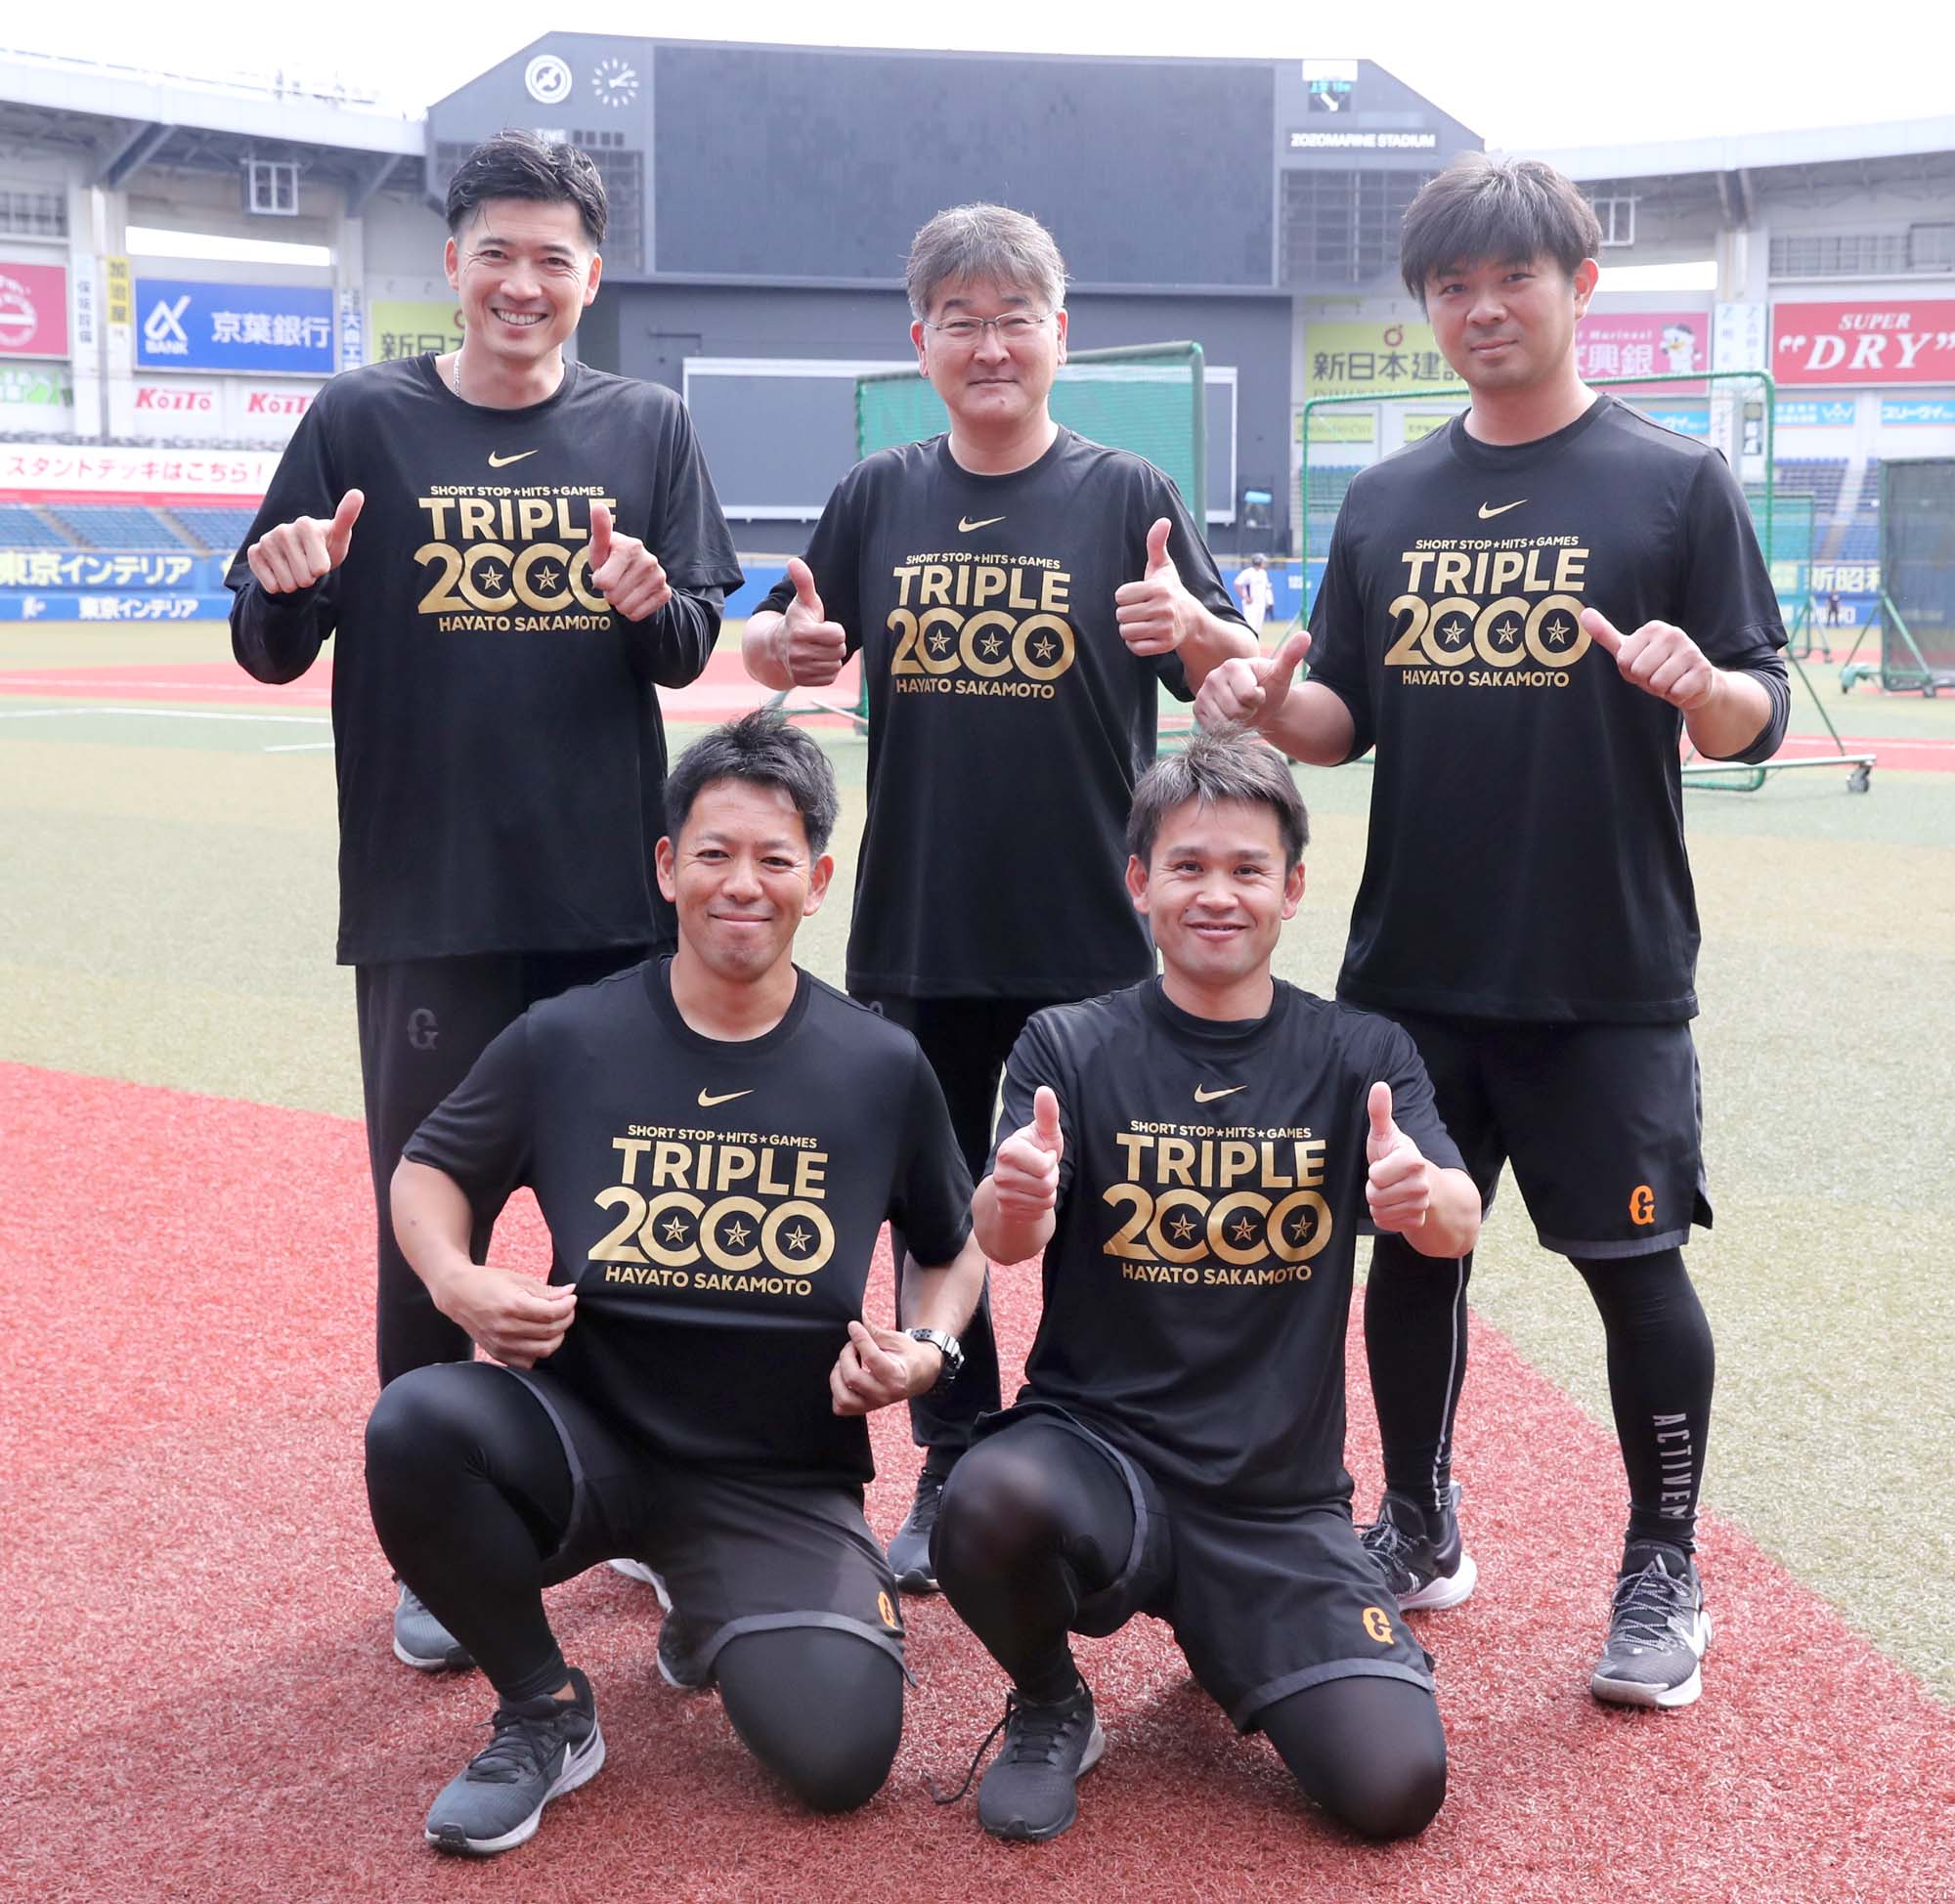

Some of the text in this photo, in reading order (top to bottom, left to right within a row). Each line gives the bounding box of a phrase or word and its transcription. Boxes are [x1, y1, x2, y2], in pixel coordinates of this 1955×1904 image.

[1377, 134, 1436, 148] STADIUM
[210, 311, 330, 349] 京葉銀行
[1838, 313, 1911, 330] SUPER
[146, 340, 189, 355] BANK
[380, 331, 464, 360] 新日
[431, 485, 474, 497] SHORT
[1415, 540, 1457, 550] SHORT
[0, 550, 193, 585] 東京インテリア
[905, 552, 940, 565] SHORT
[1401, 548, 1589, 595] TRIPLE
[892, 564, 1071, 614] TRIPLE
[78, 596, 199, 621] 東京インテリア
[439, 616, 611, 632] HAYATO SAKAMOTO
[895, 678, 1055, 700] HAYATO SAKAMOTO
[1403, 670, 1570, 688] HAYATO SAKAMOTO
[406, 1008, 439, 1051] G
[628, 1124, 675, 1140] SHORT
[1130, 1120, 1177, 1136] SHORT
[612, 1137, 829, 1199] TRIPLE
[1115, 1132, 1326, 1189] TRIPLE
[1629, 1185, 1655, 1226] G
[605, 1266, 812, 1296] HAYATO SAKAMOTO
[1122, 1263, 1312, 1286] HAYATO SAKAMOTO
[1363, 1606, 1395, 1645] G
